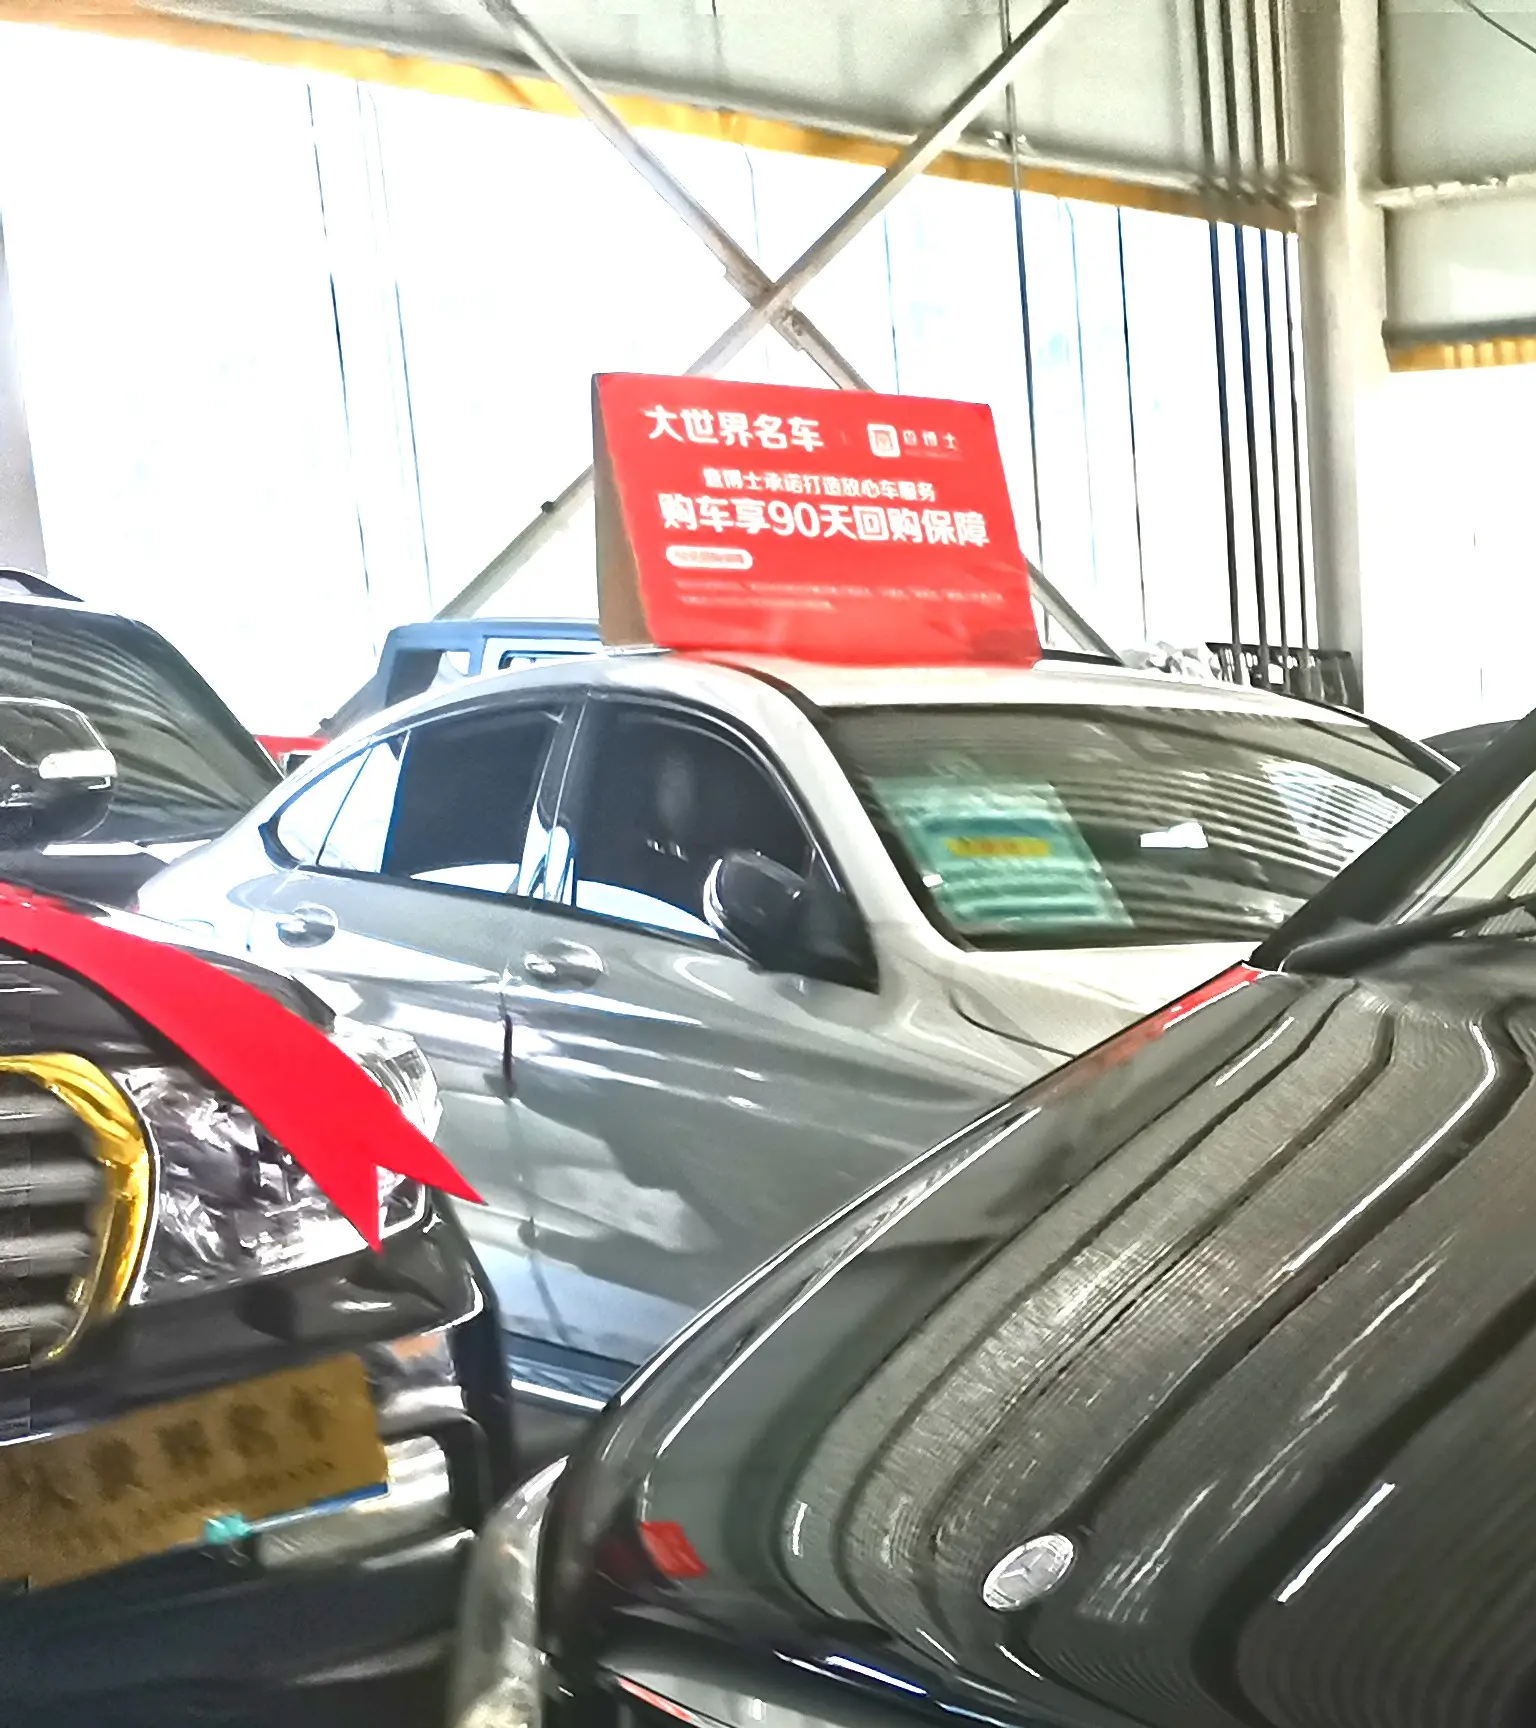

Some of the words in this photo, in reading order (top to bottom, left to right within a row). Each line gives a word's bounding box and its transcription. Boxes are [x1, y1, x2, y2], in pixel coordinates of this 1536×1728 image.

[645, 405, 824, 452] 大世界名车
[658, 493, 989, 548] 购车享90天回购保障
